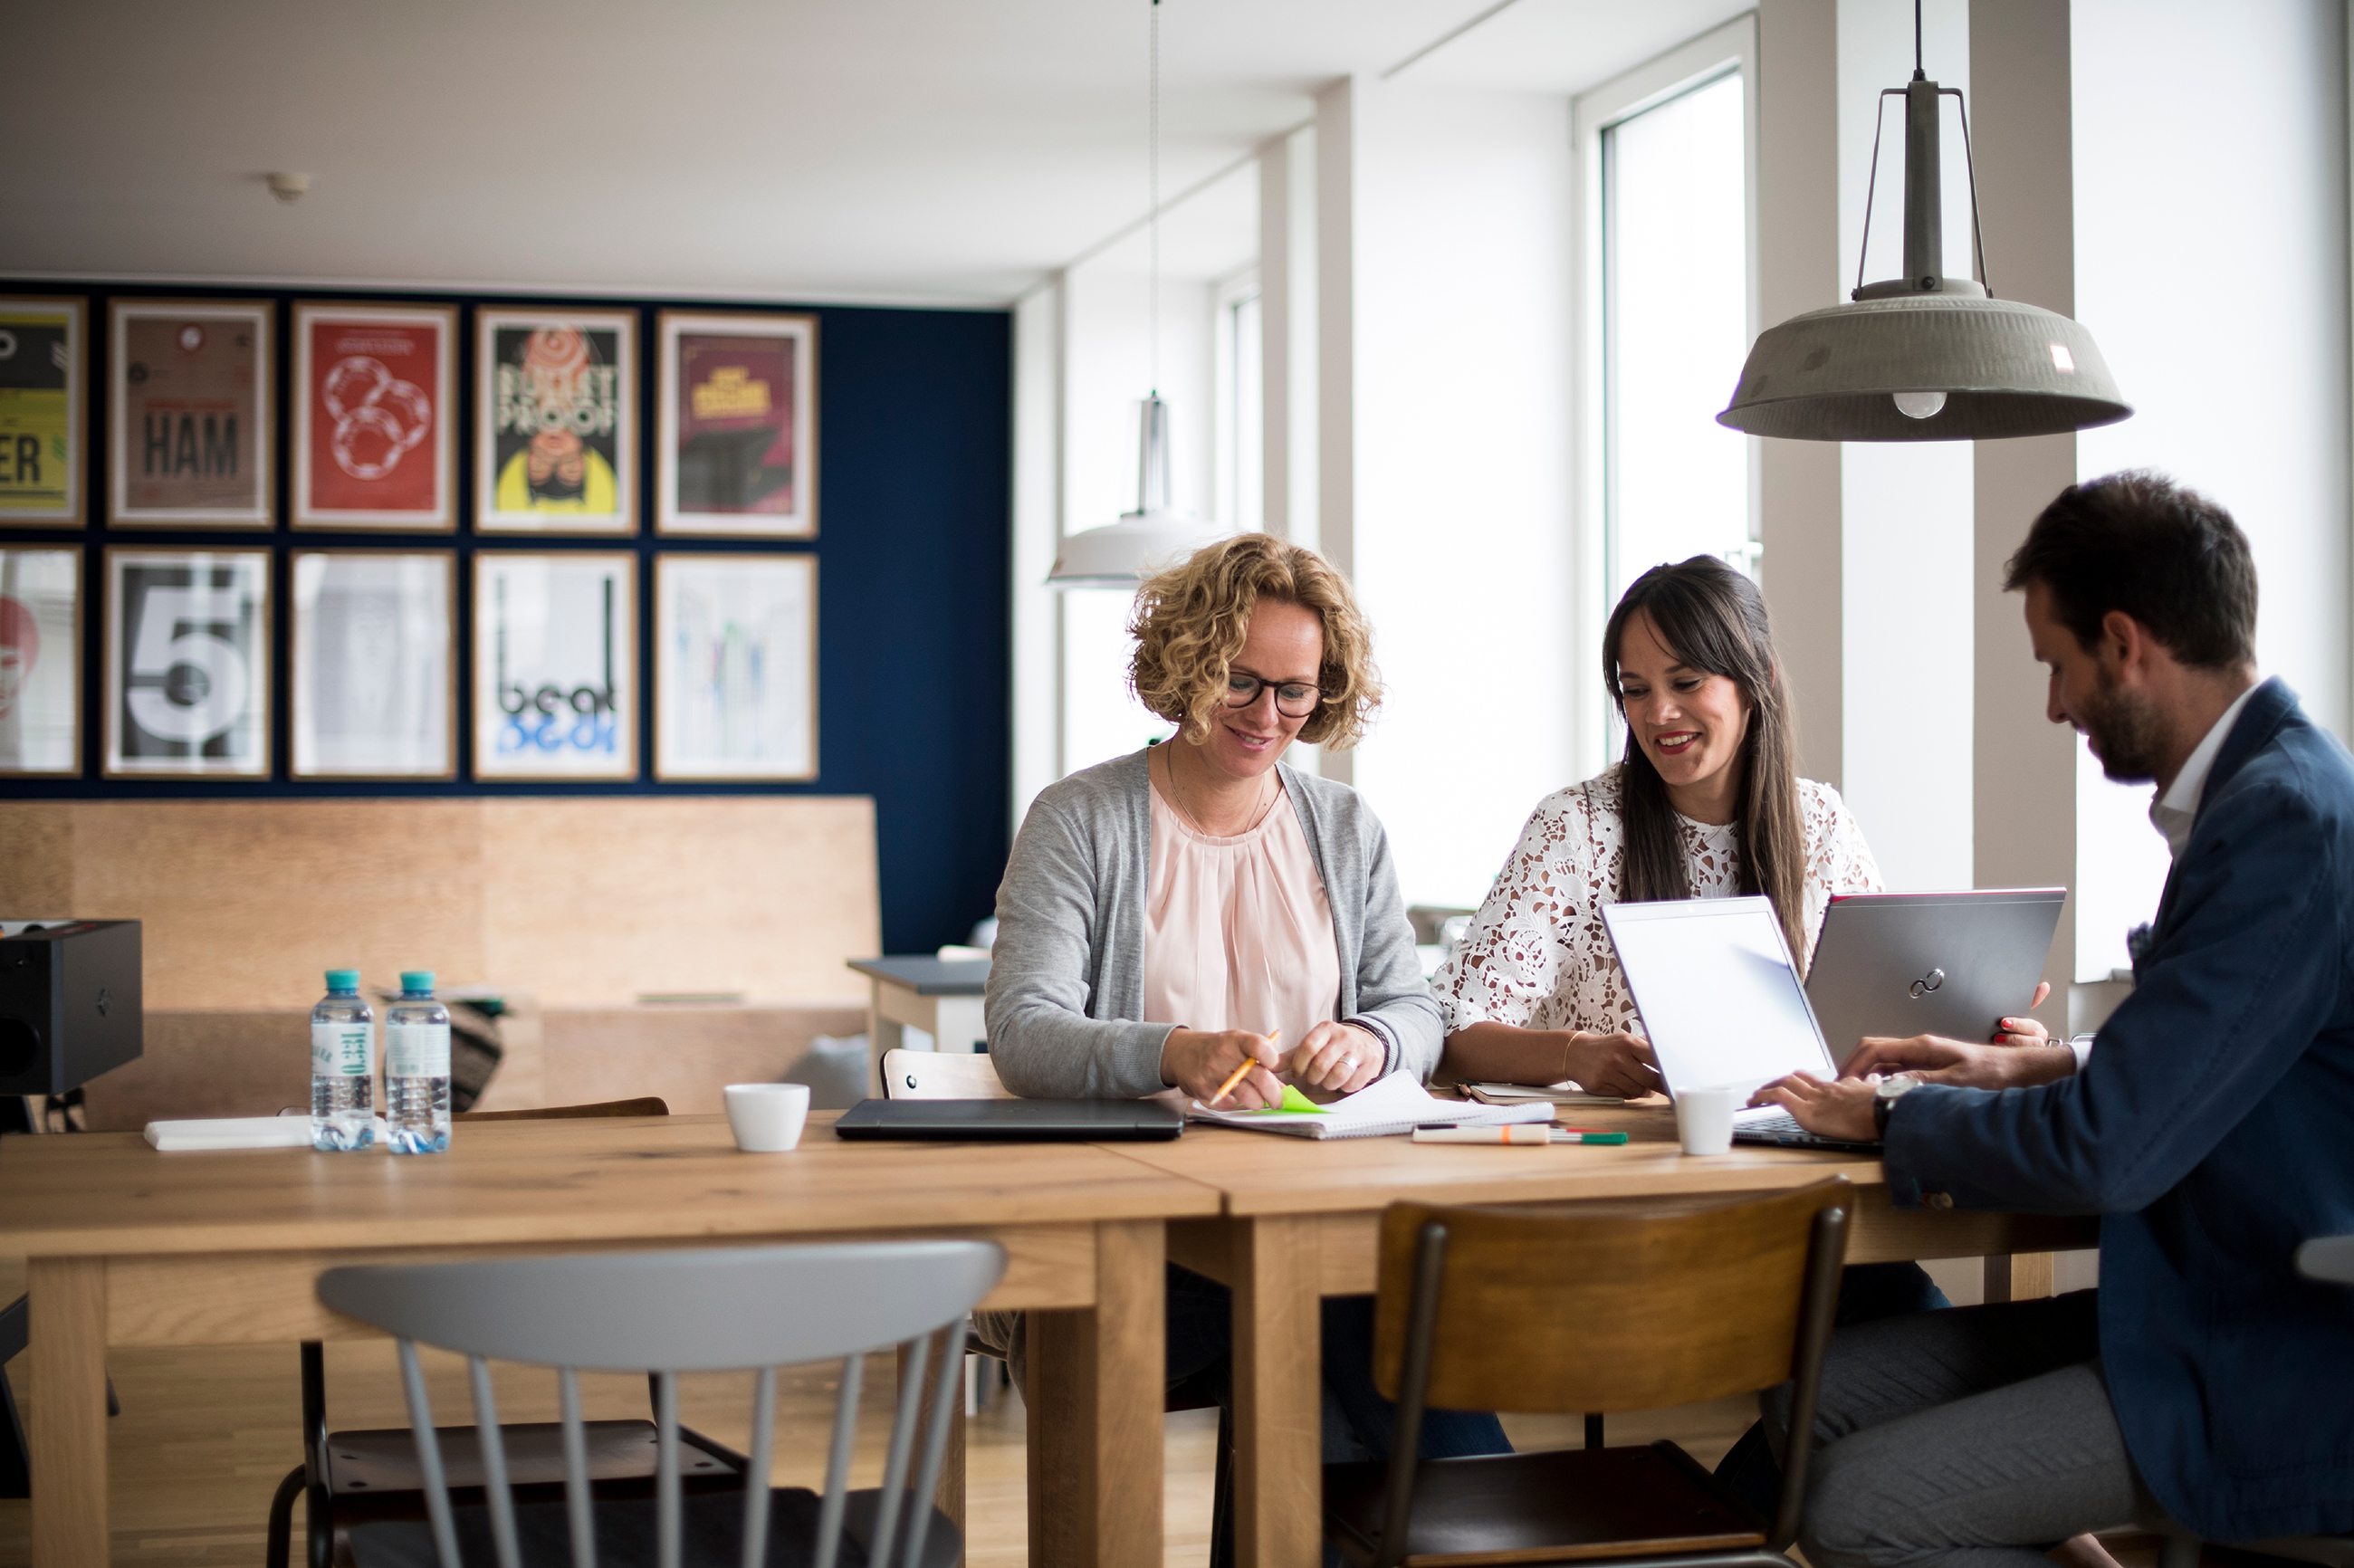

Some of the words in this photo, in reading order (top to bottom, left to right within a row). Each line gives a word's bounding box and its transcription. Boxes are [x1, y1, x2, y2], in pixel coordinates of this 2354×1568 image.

[144, 413, 238, 478] HAM
[498, 396, 616, 435] PROOF
[128, 586, 246, 741] 5
